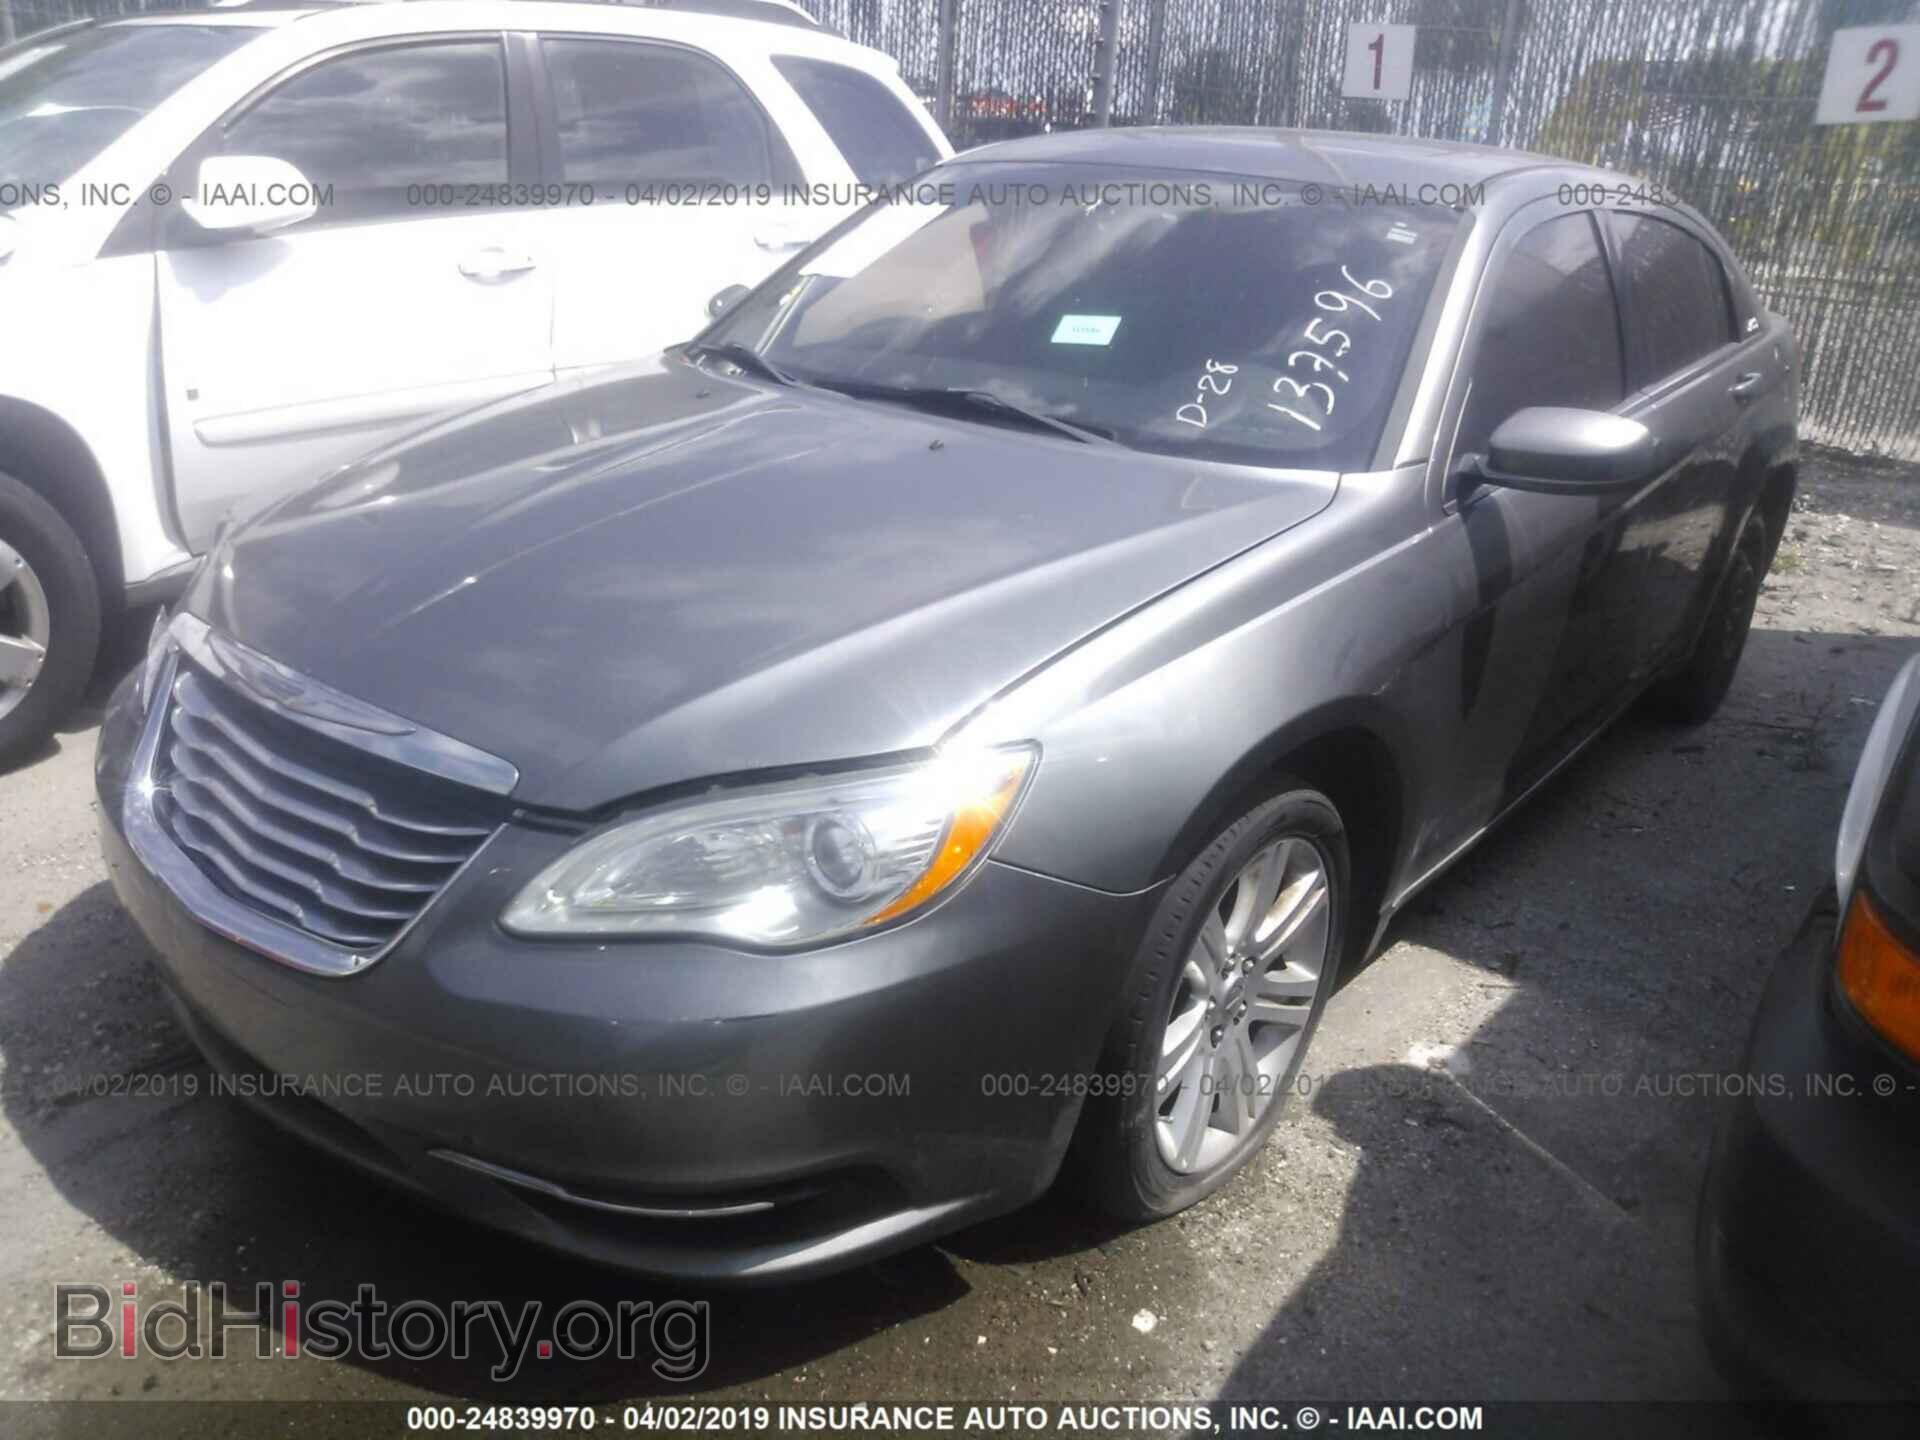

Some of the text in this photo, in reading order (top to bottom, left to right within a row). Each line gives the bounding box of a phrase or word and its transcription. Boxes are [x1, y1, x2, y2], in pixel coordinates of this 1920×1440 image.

[1367, 33, 1384, 91] 1
[1855, 38, 1900, 113] 2
[1176, 358, 1238, 429] D-28
